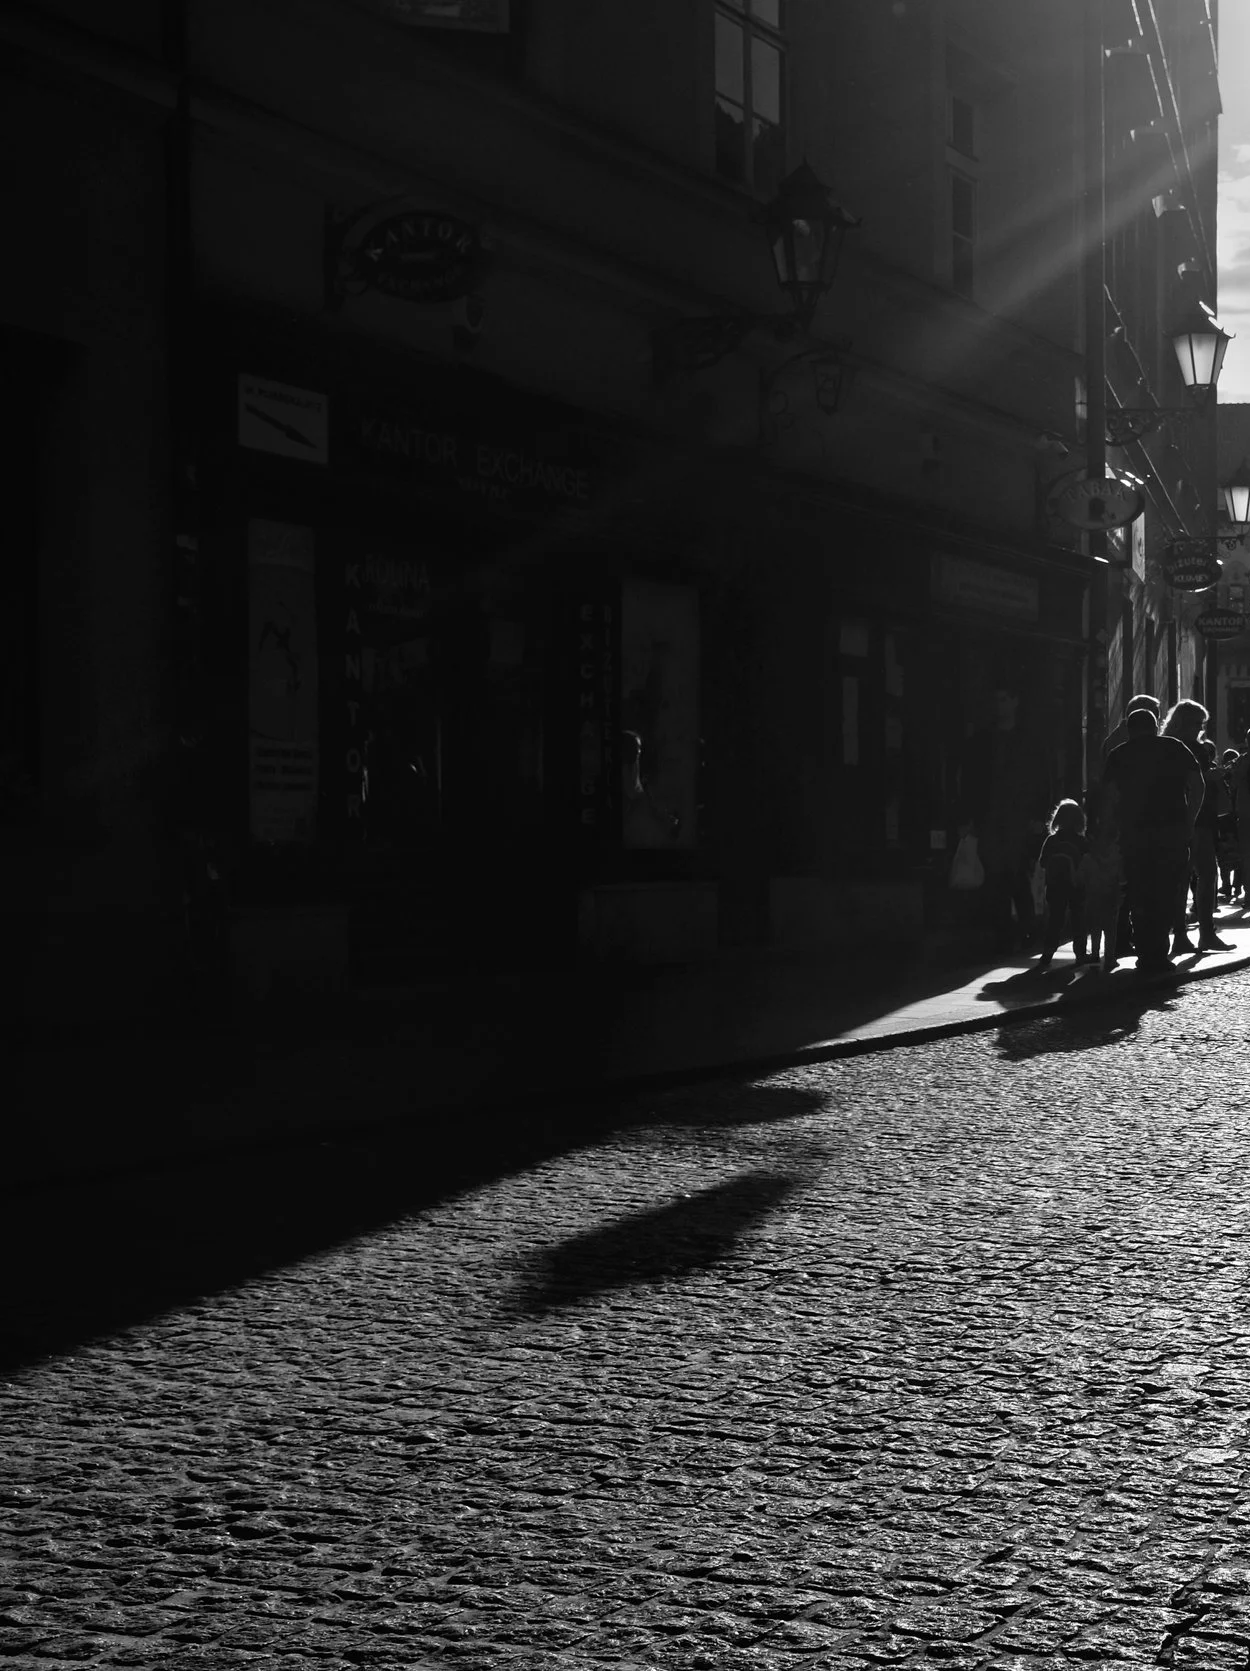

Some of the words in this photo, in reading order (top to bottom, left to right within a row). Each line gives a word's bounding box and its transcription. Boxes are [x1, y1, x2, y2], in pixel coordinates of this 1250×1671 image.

[364, 216, 474, 263] KANTOR
[361, 415, 459, 469] KANTOR
[476, 443, 590, 502] EXCHANGE
[1198, 616, 1243, 626] KANTOR
[344, 562, 362, 820] KANTOR
[580, 602, 597, 826] EXCHAGE
